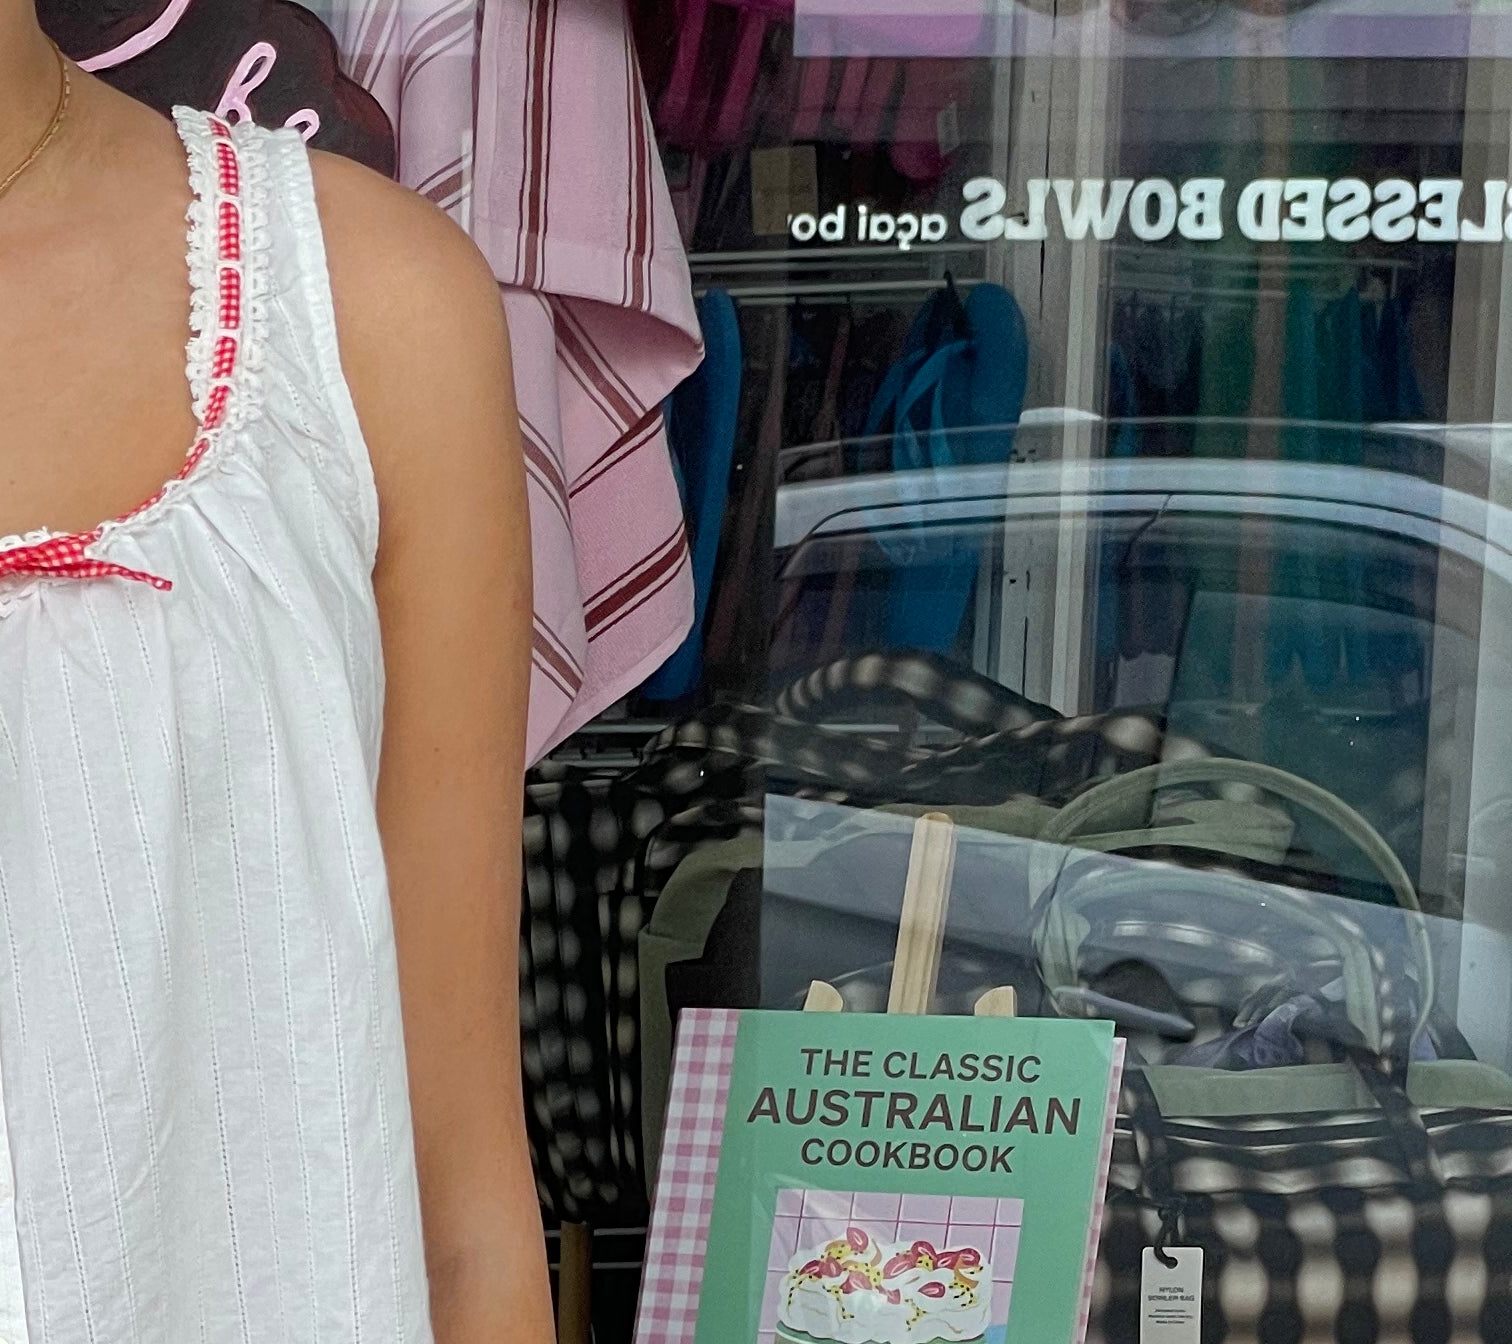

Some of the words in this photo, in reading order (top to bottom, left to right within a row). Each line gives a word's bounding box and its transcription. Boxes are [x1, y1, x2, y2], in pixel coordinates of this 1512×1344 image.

[801, 1048, 873, 1078] THE
[883, 1051, 1041, 1083] CLASSIC
[746, 1087, 1081, 1135] AUSTRALIAN
[800, 1137, 1016, 1173] COOKBOOK
